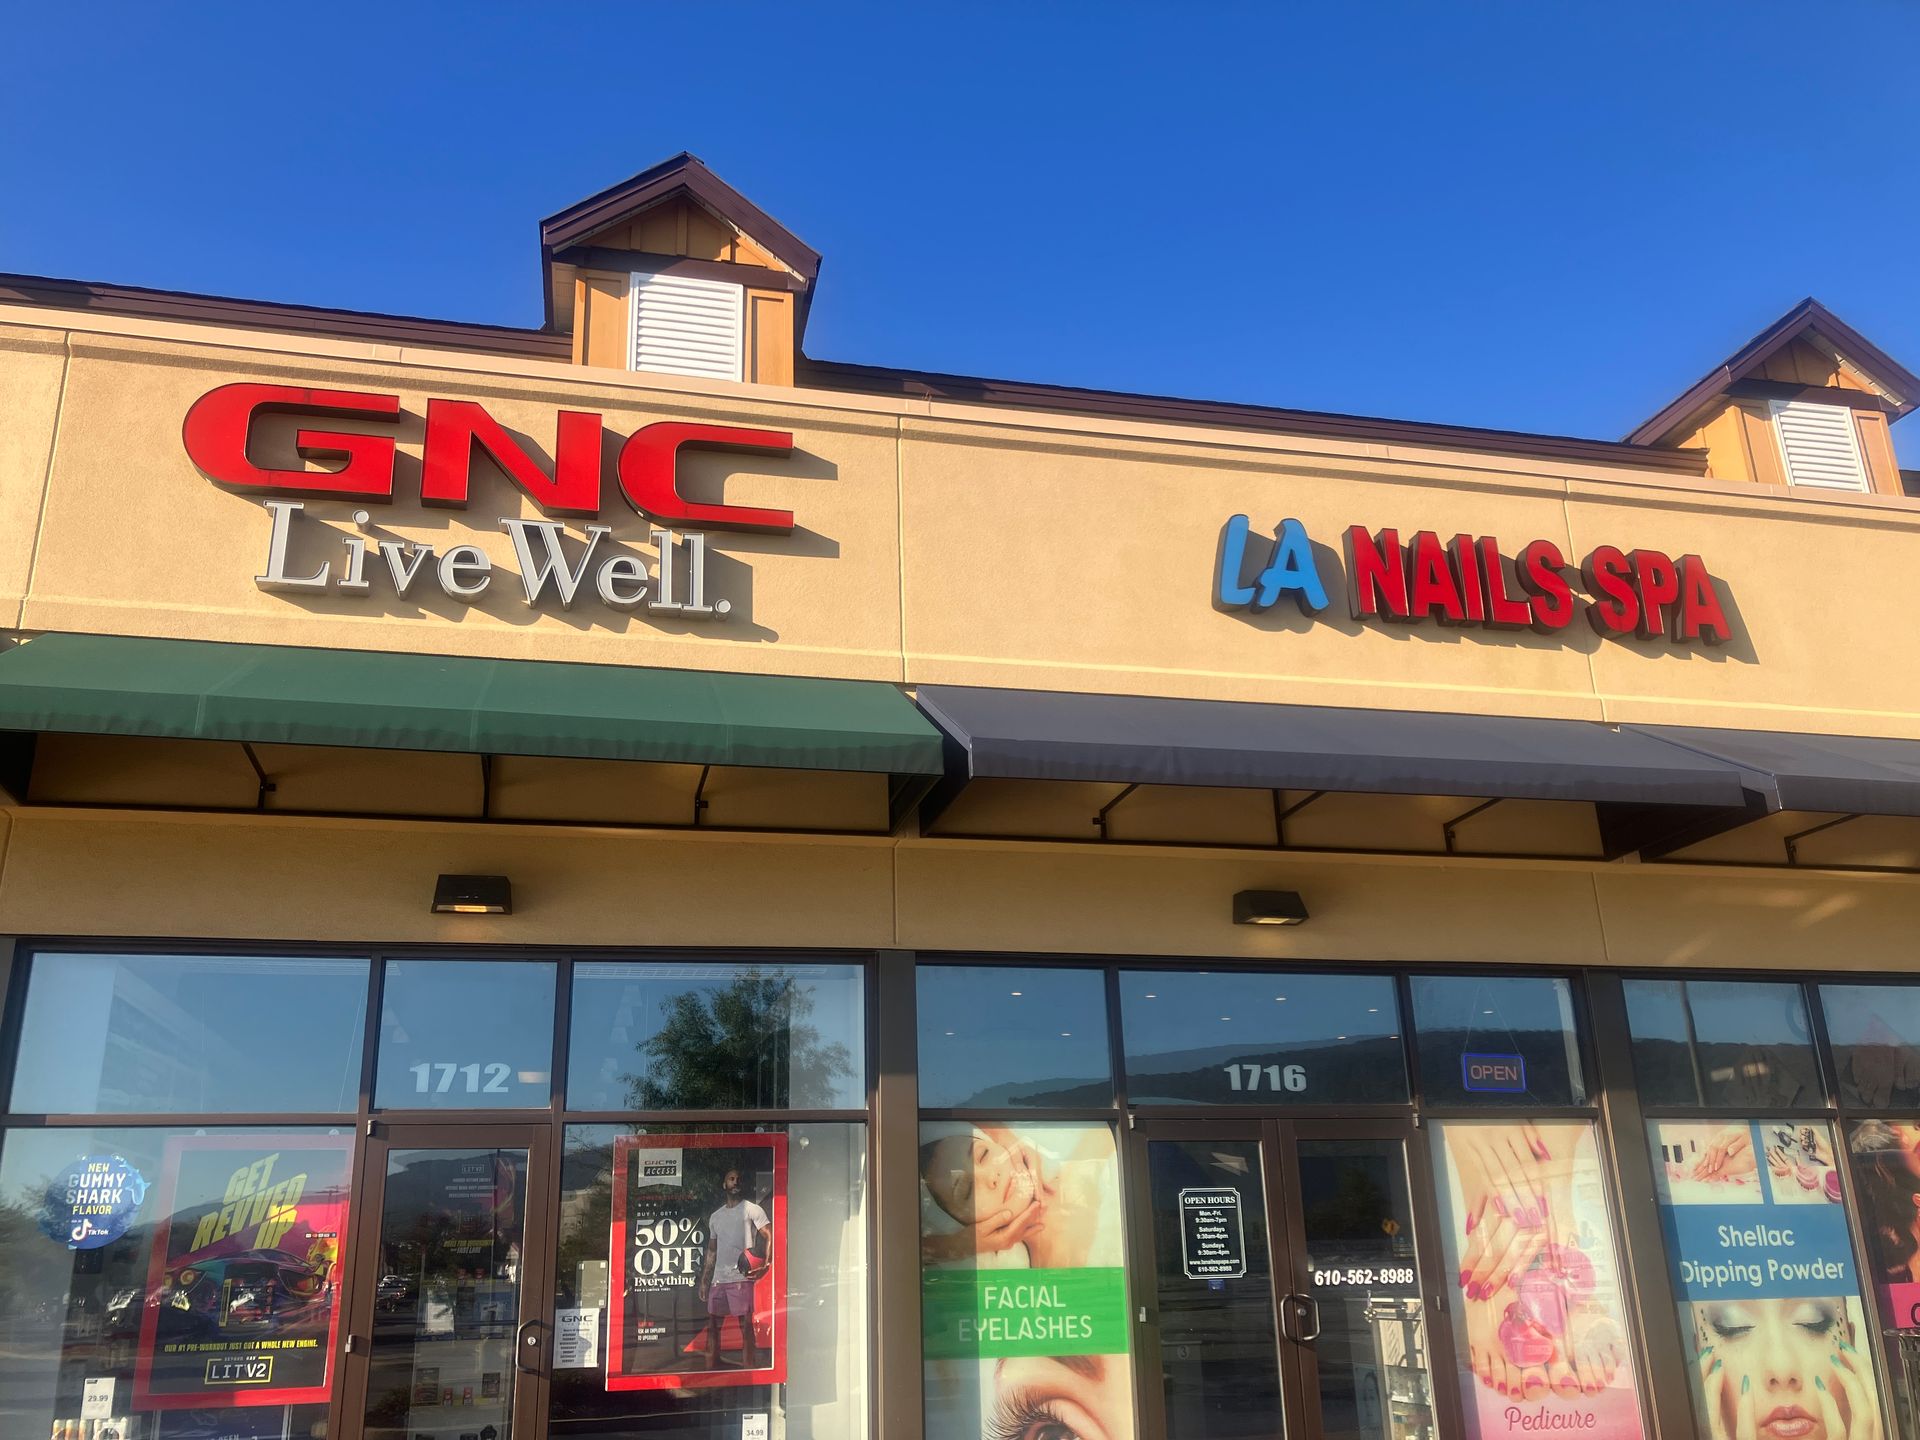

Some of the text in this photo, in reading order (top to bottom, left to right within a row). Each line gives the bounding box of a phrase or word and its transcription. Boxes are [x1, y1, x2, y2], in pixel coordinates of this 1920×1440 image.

[182, 382, 794, 537] GNC
[1213, 513, 1734, 647] LA NAILS SPA
[409, 1062, 512, 1094] 1712
[1224, 1063, 1307, 1093] 1716
[1470, 1064, 1518, 1082] OPEN
[68, 1173, 126, 1188] GUMMY
[88, 1163, 110, 1173] NEW
[223, 1152, 280, 1206] GET
[645, 1167, 675, 1175] ACCESS
[66, 1189, 123, 1205] SHARK
[72, 1205, 112, 1215] FLAVOR
[1184, 1196, 1236, 1204] OPEN HOURS
[190, 1173, 308, 1253] REVVED
[253, 1206, 298, 1250] UP
[635, 1217, 705, 1247] 50%
[1718, 1224, 1796, 1248] Shellac
[634, 1246, 704, 1276] OFF
[1680, 1258, 1845, 1288] Dipping Powder
[634, 1275, 696, 1287] Everything
[1314, 1268, 1414, 1286] 610-562-8988
[984, 1285, 1067, 1311] FACIAL
[561, 1315, 593, 1323] GNC
[958, 1315, 1093, 1343] EYELASHES
[228, 1342, 243, 1351] JUST
[243, 1341, 255, 1350] GOT
[261, 1340, 281, 1350] WHOLE
[281, 1339, 296, 1349] NEW
[1504, 1406, 1597, 1432] Pedicure
